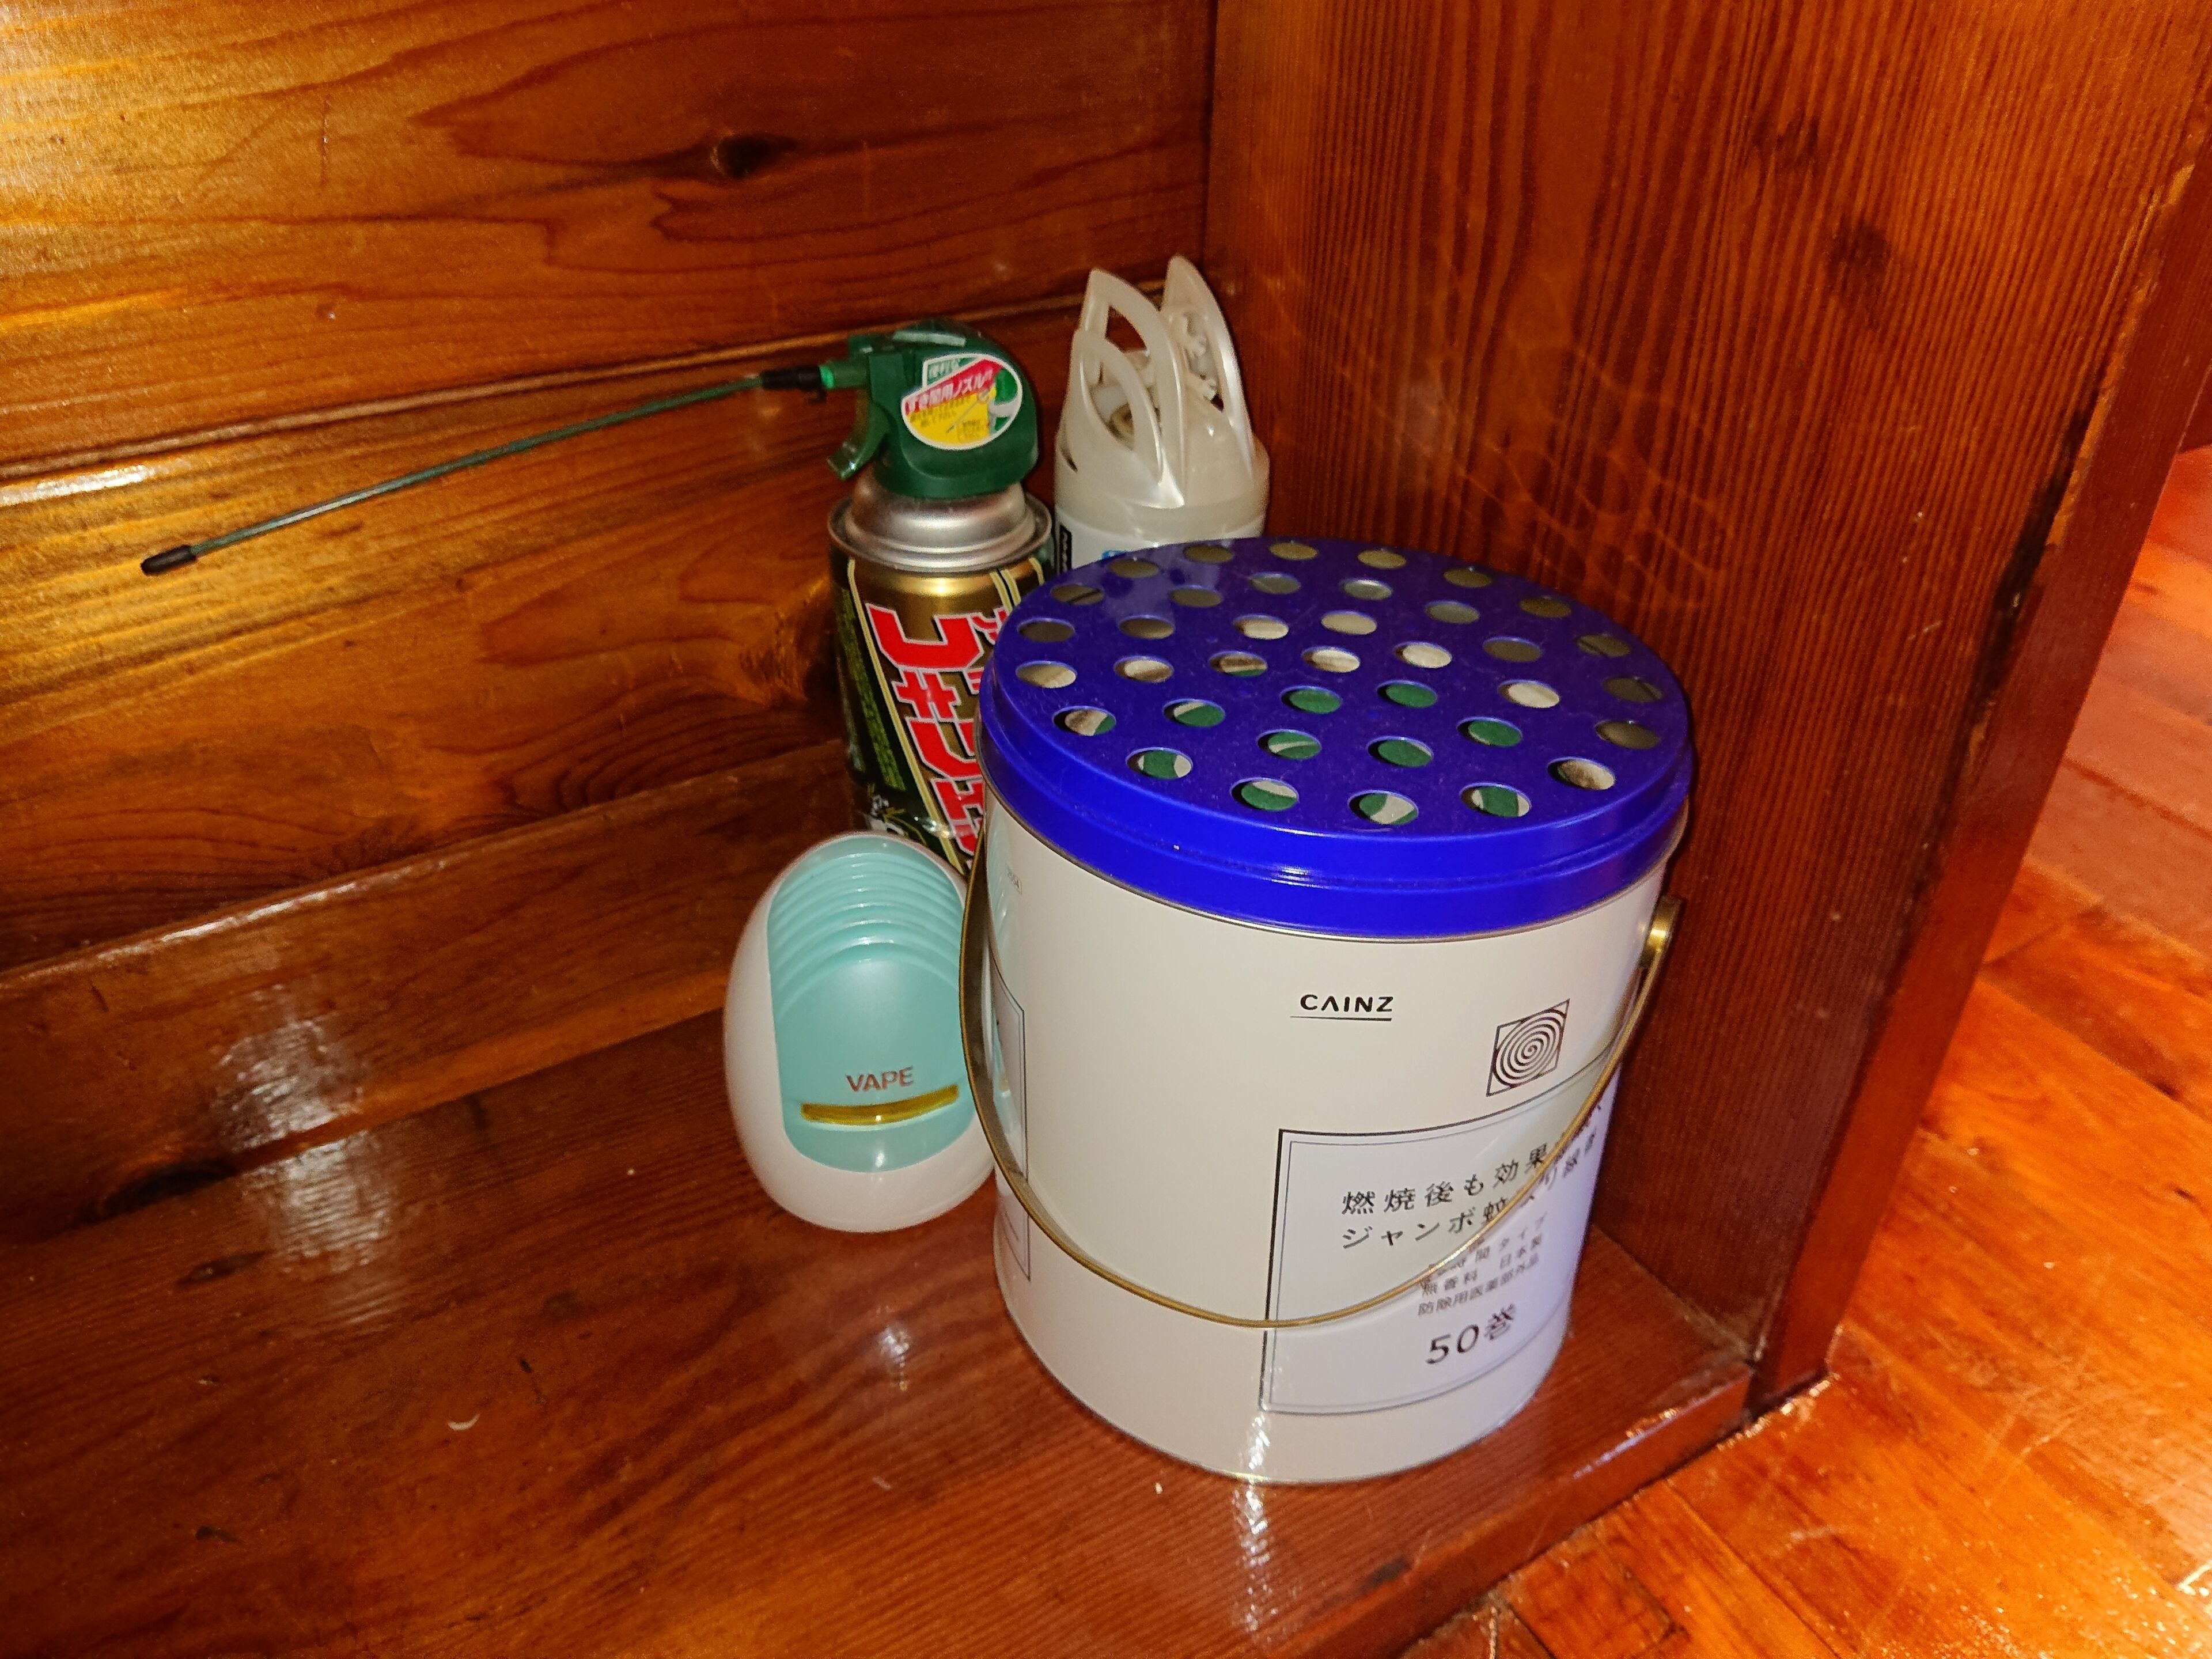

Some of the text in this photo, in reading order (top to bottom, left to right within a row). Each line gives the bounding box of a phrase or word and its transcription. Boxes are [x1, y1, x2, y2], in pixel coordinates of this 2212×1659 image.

[1300, 994, 1394, 1013] CAINZ
[845, 1065, 915, 1092] VAPE
[1425, 1304, 1517, 1365] 50巻
